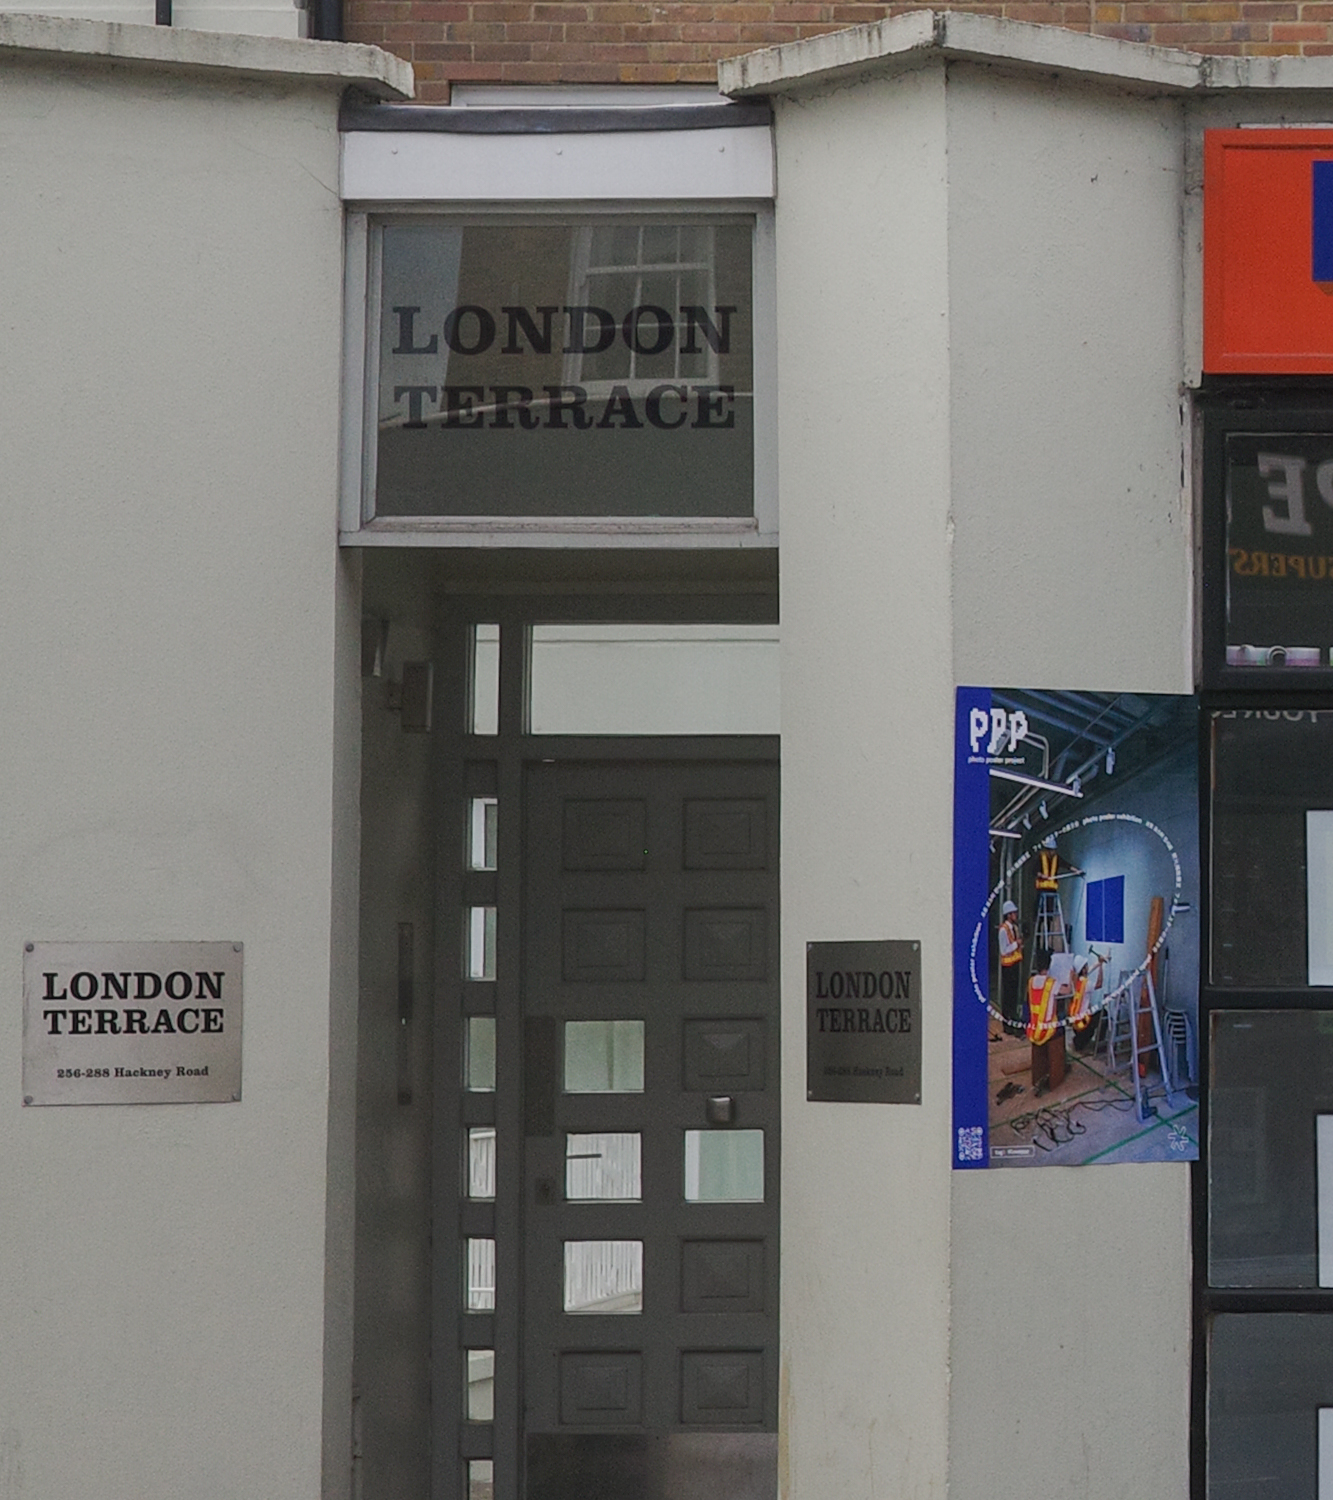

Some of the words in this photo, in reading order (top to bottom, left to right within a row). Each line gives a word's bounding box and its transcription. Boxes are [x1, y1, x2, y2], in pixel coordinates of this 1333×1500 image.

[392, 306, 737, 355] LONDON
[394, 385, 736, 430] TERRACE
[42, 971, 225, 1000] LONDON
[816, 971, 911, 999] LONDON
[43, 1008, 224, 1035] TERRACE
[816, 1008, 911, 1033] TERRACE
[57, 1068, 110, 1078] 256-288
[114, 1066, 172, 1080] Hackney
[176, 1065, 209, 1077] Road
